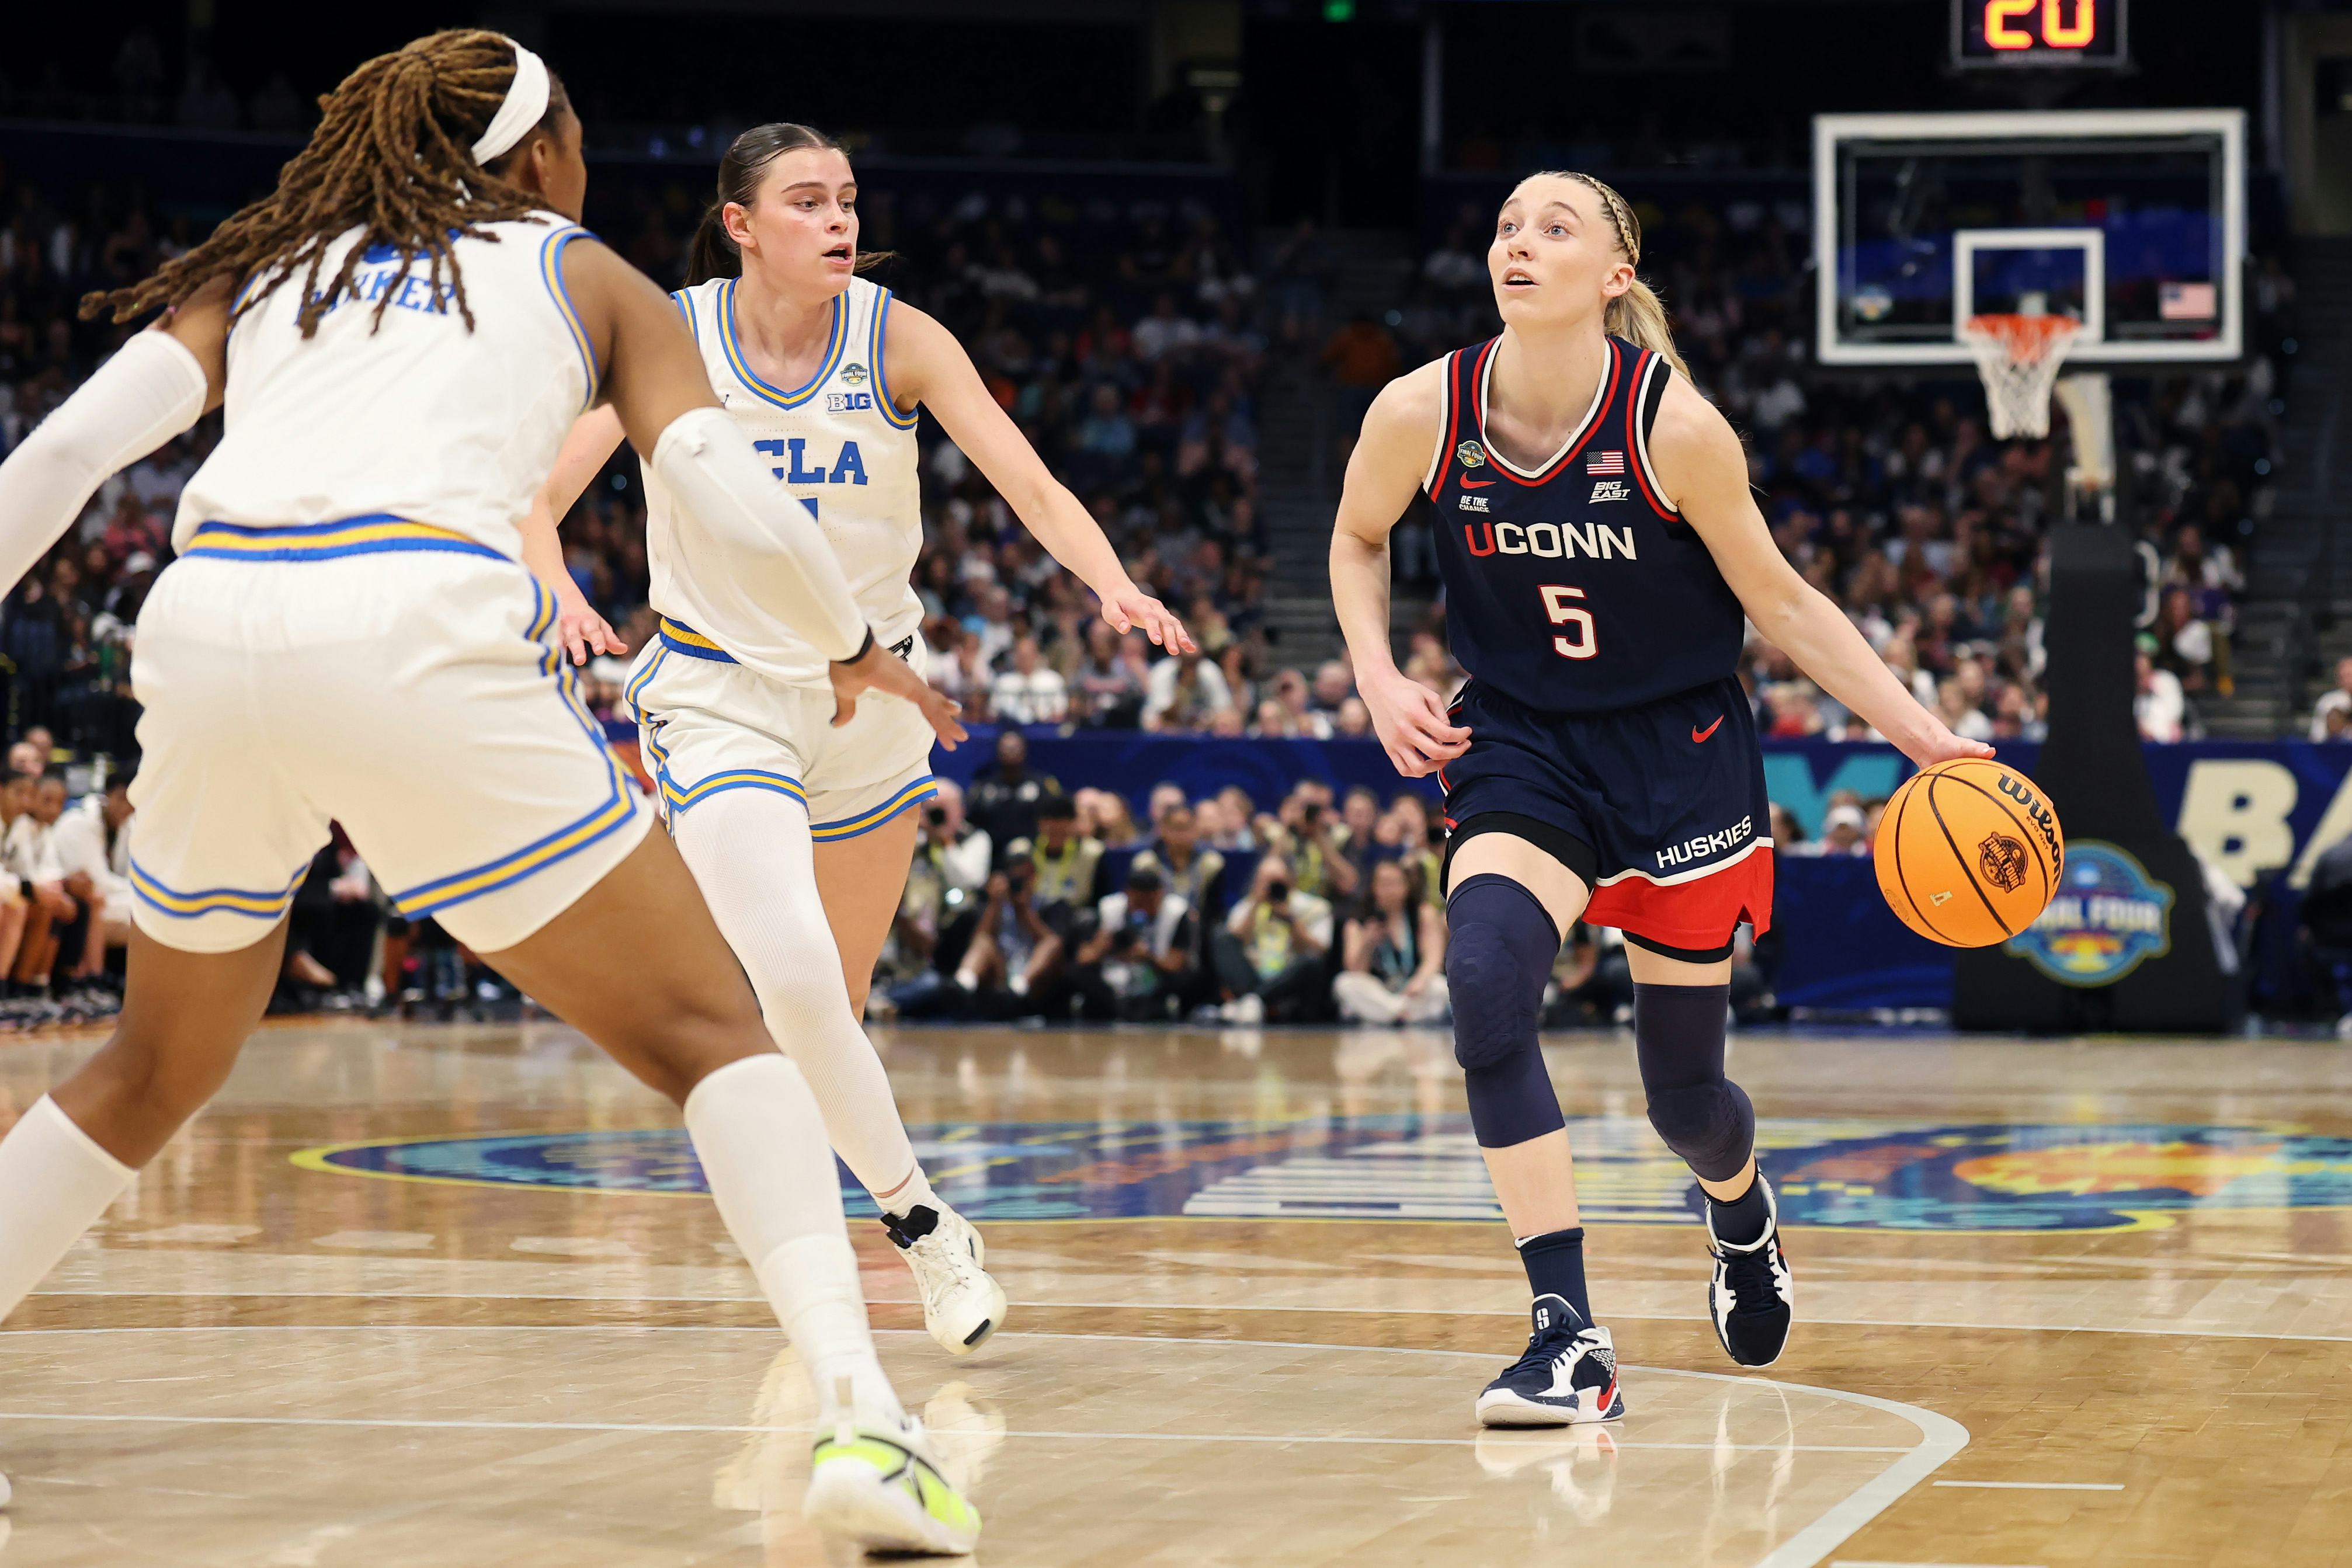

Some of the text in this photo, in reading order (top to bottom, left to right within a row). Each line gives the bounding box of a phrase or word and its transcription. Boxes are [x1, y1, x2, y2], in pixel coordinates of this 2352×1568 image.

[1985, 0, 2095, 49] 20
[752, 439, 868, 485] CLA
[1460, 495, 1489, 507] BE THE
[1590, 489, 1631, 499] EAST
[1593, 481, 1623, 491] BIG
[1464, 522, 1637, 561] UCONN
[1537, 584, 1599, 660] 5
[1656, 815, 1752, 869] HUSKIES
[1985, 837, 2020, 889] FINAL FOUR
